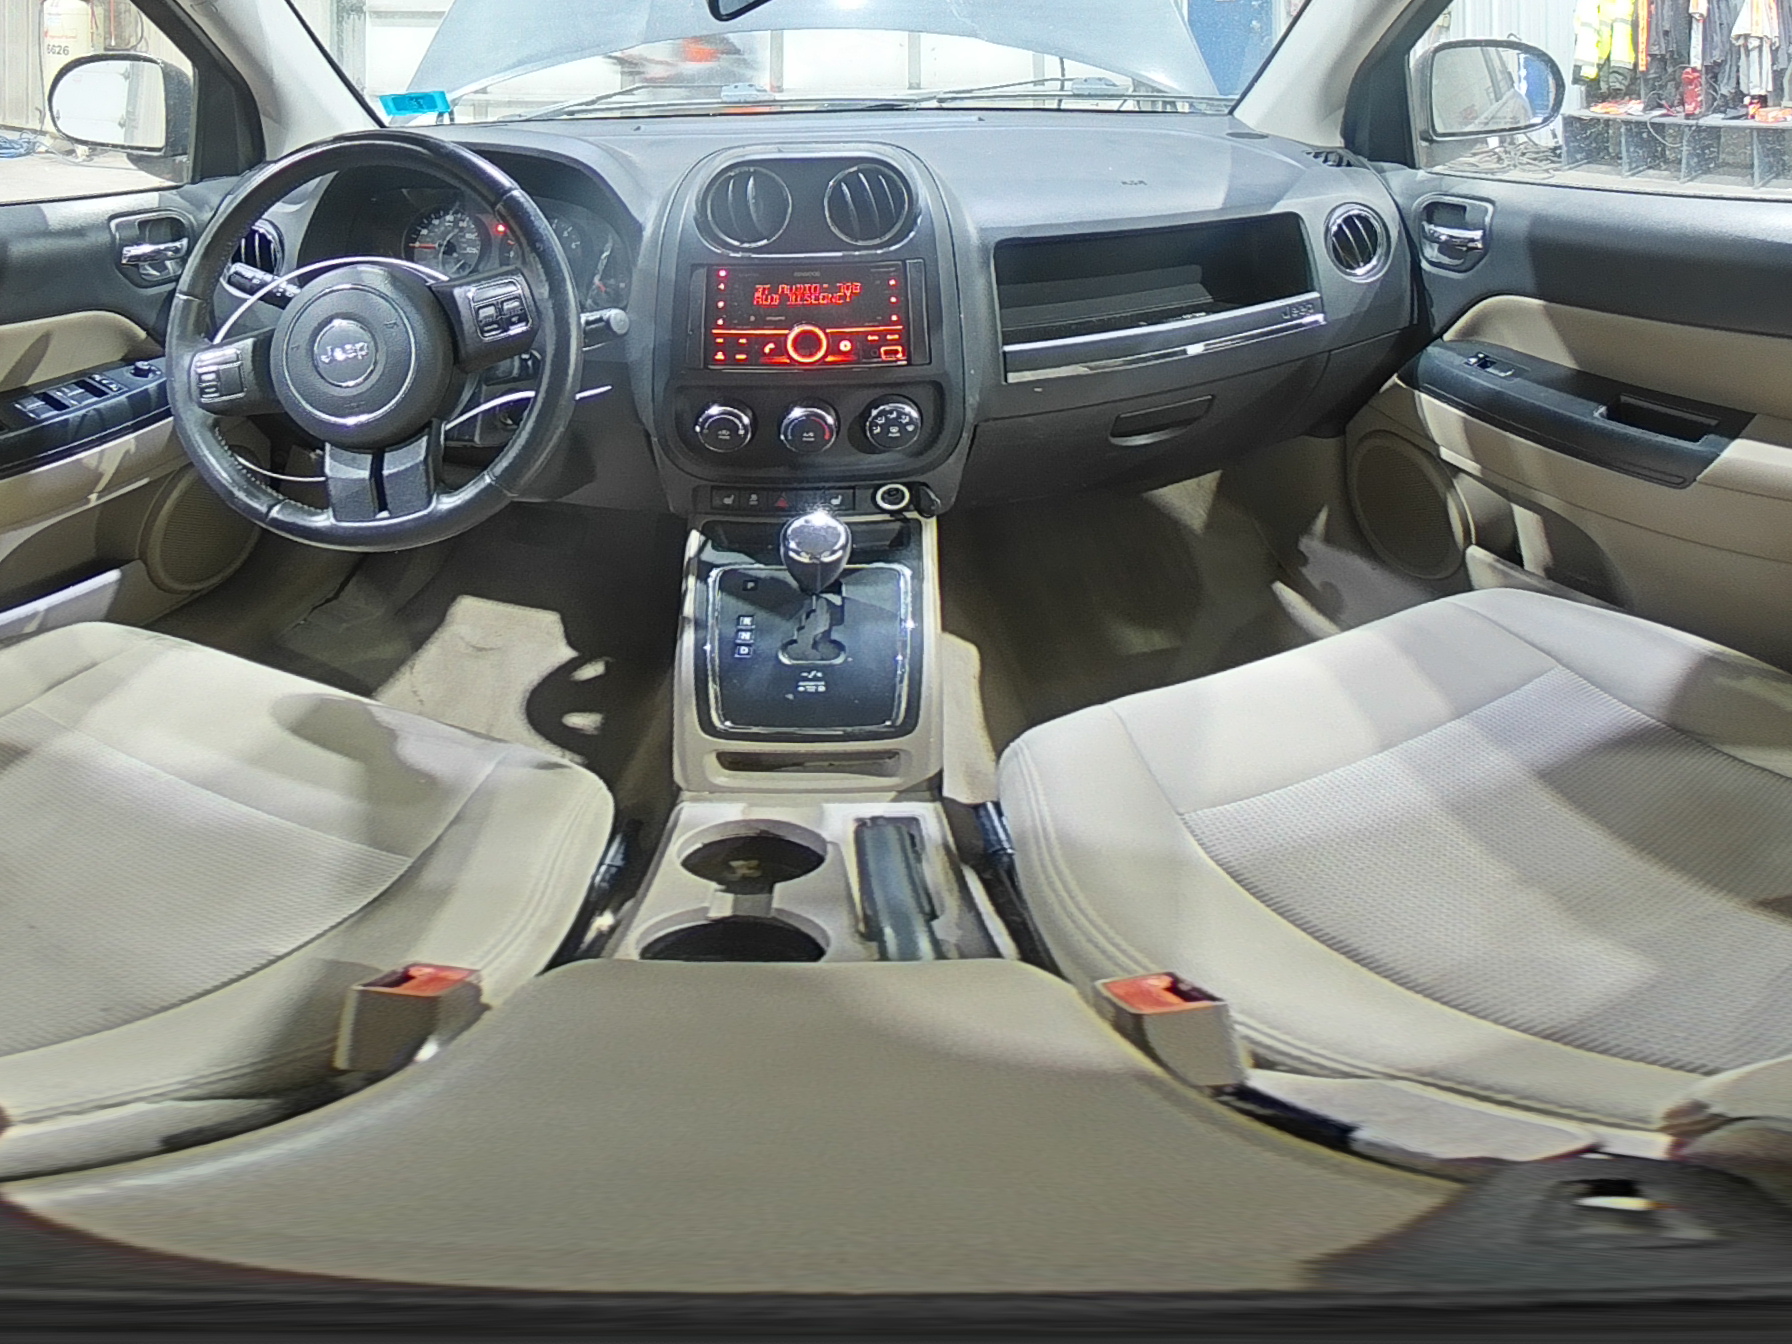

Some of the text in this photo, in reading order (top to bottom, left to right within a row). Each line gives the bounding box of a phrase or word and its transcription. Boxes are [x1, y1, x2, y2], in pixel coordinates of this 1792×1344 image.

[1281, 303, 1314, 319] Jeep
[320, 342, 369, 363] Jeep
[747, 581, 755, 589] P
[739, 646, 749, 654] D
